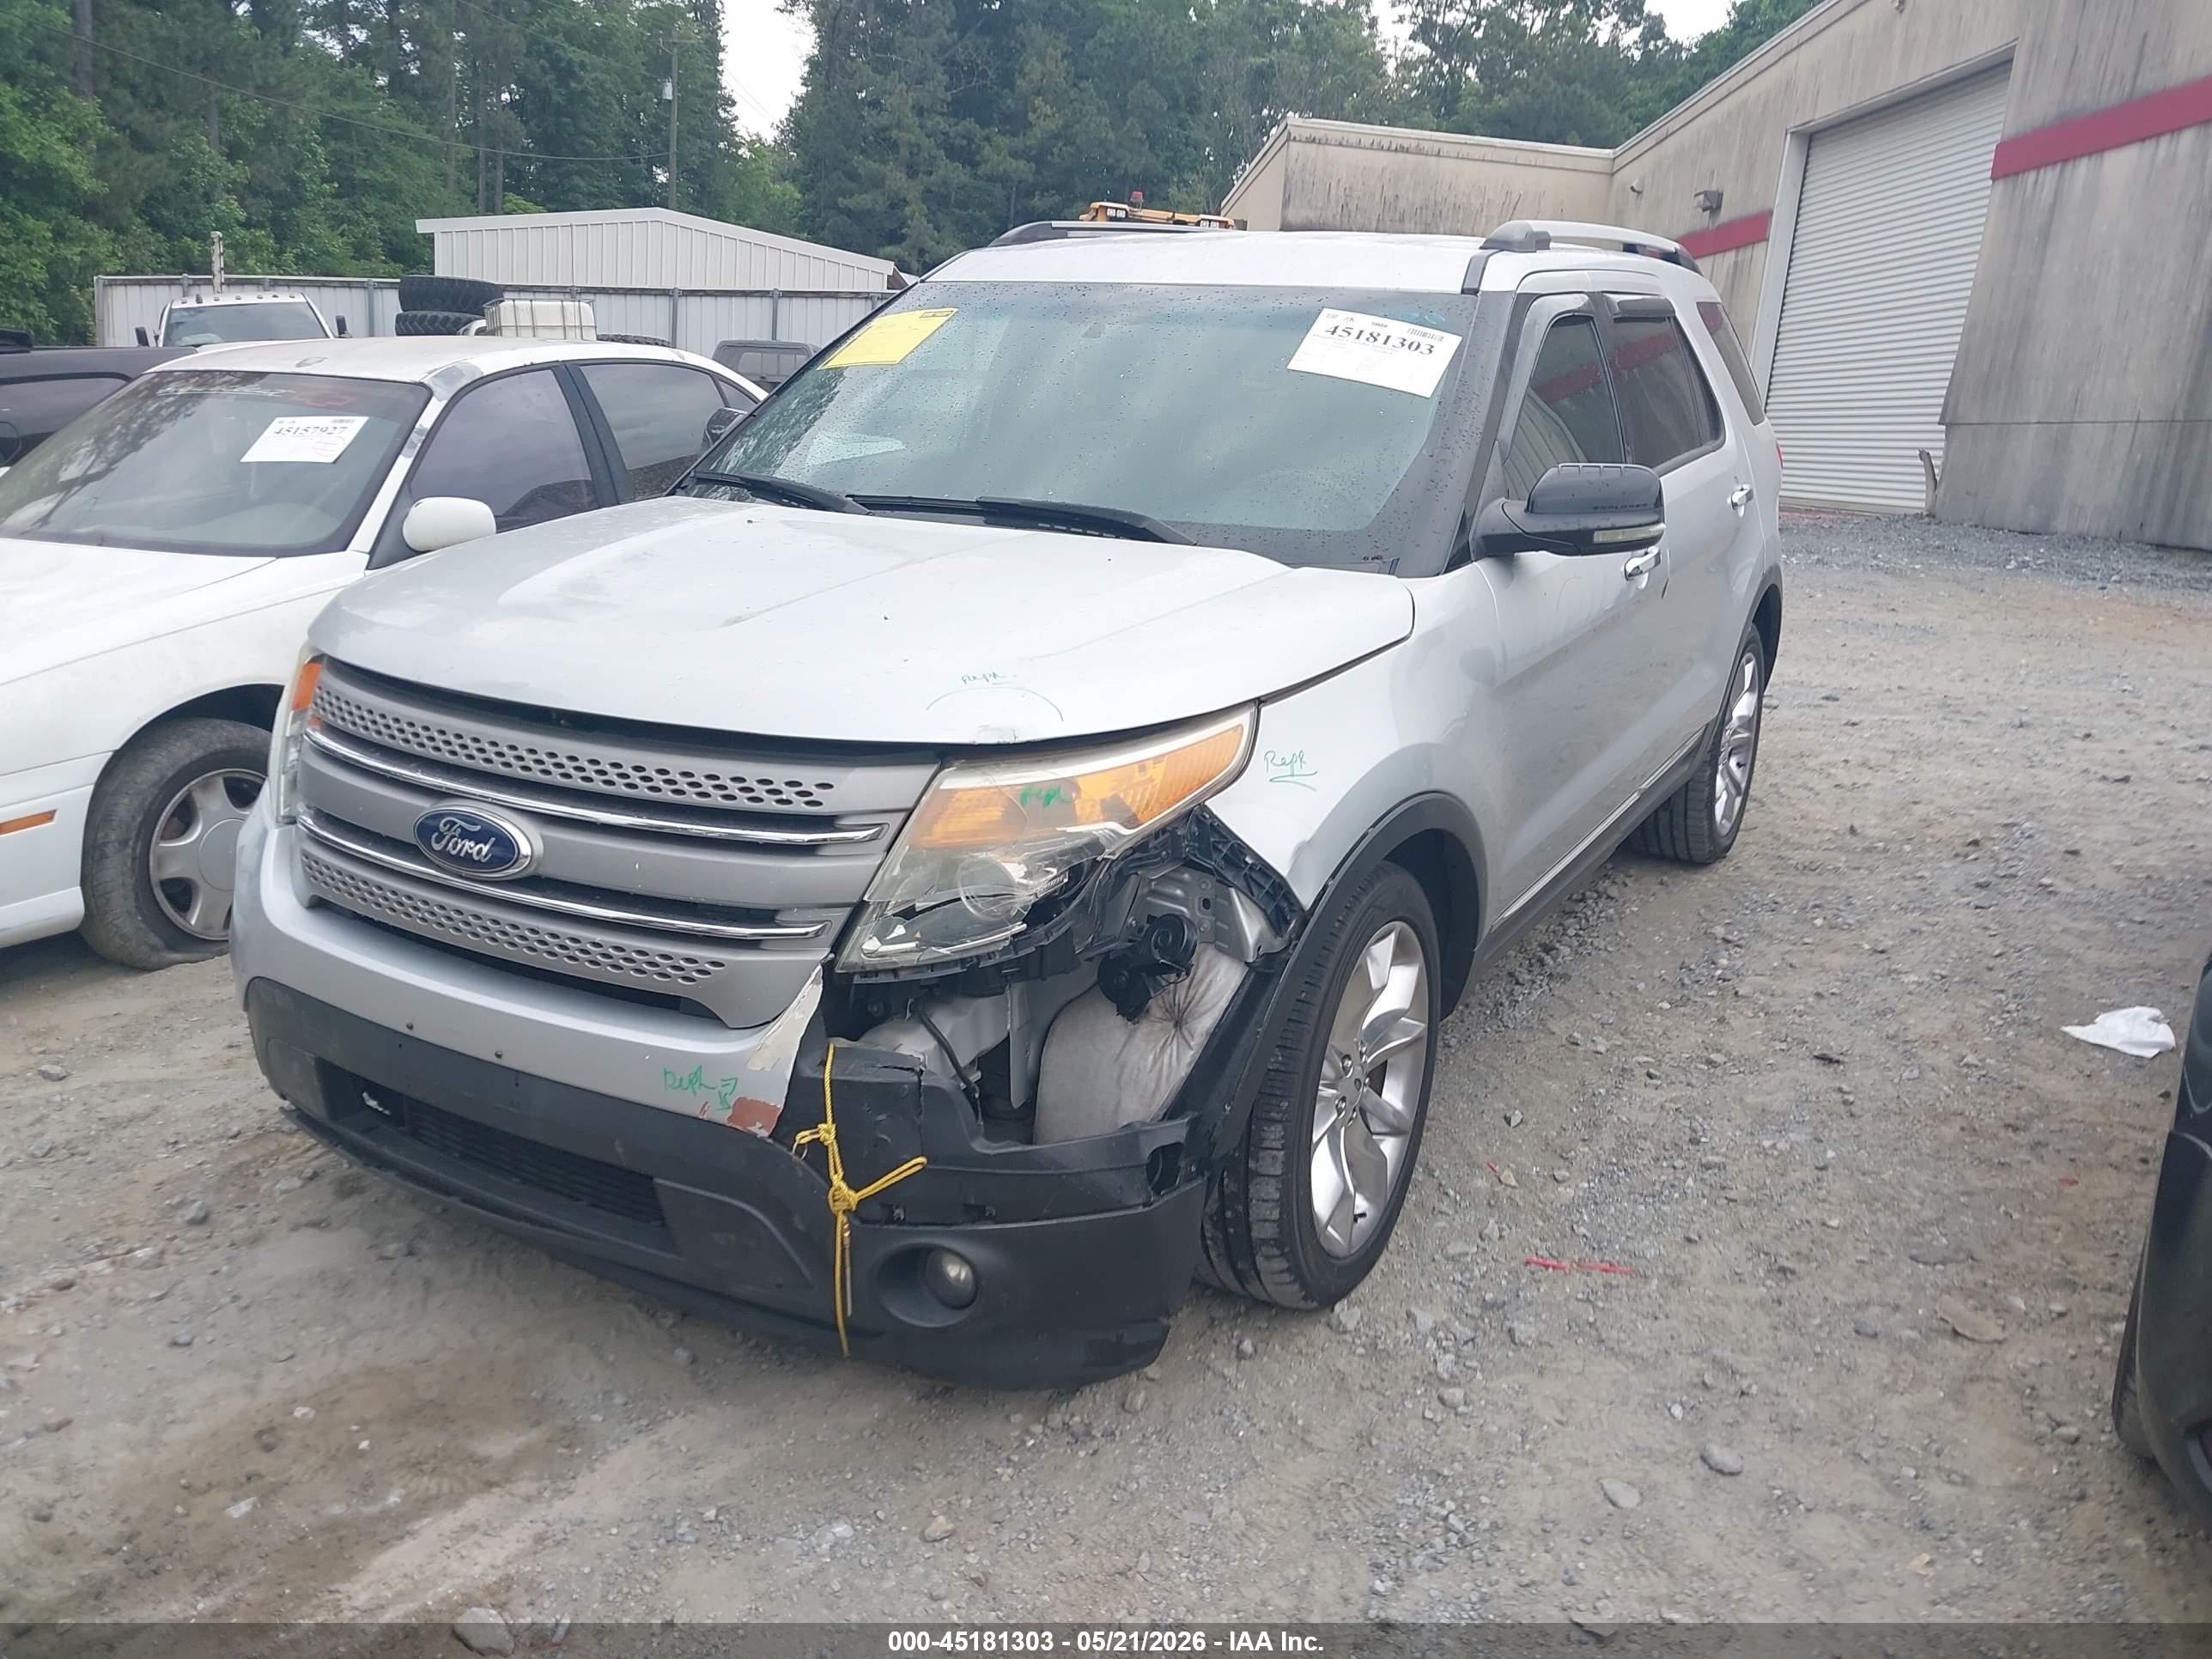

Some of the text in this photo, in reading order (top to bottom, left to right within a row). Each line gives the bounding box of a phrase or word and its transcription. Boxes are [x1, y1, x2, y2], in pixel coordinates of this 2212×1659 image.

[1325, 325, 1435, 355] 45181303
[274, 426, 349, 435] 45157927
[431, 817, 496, 863] Ford
